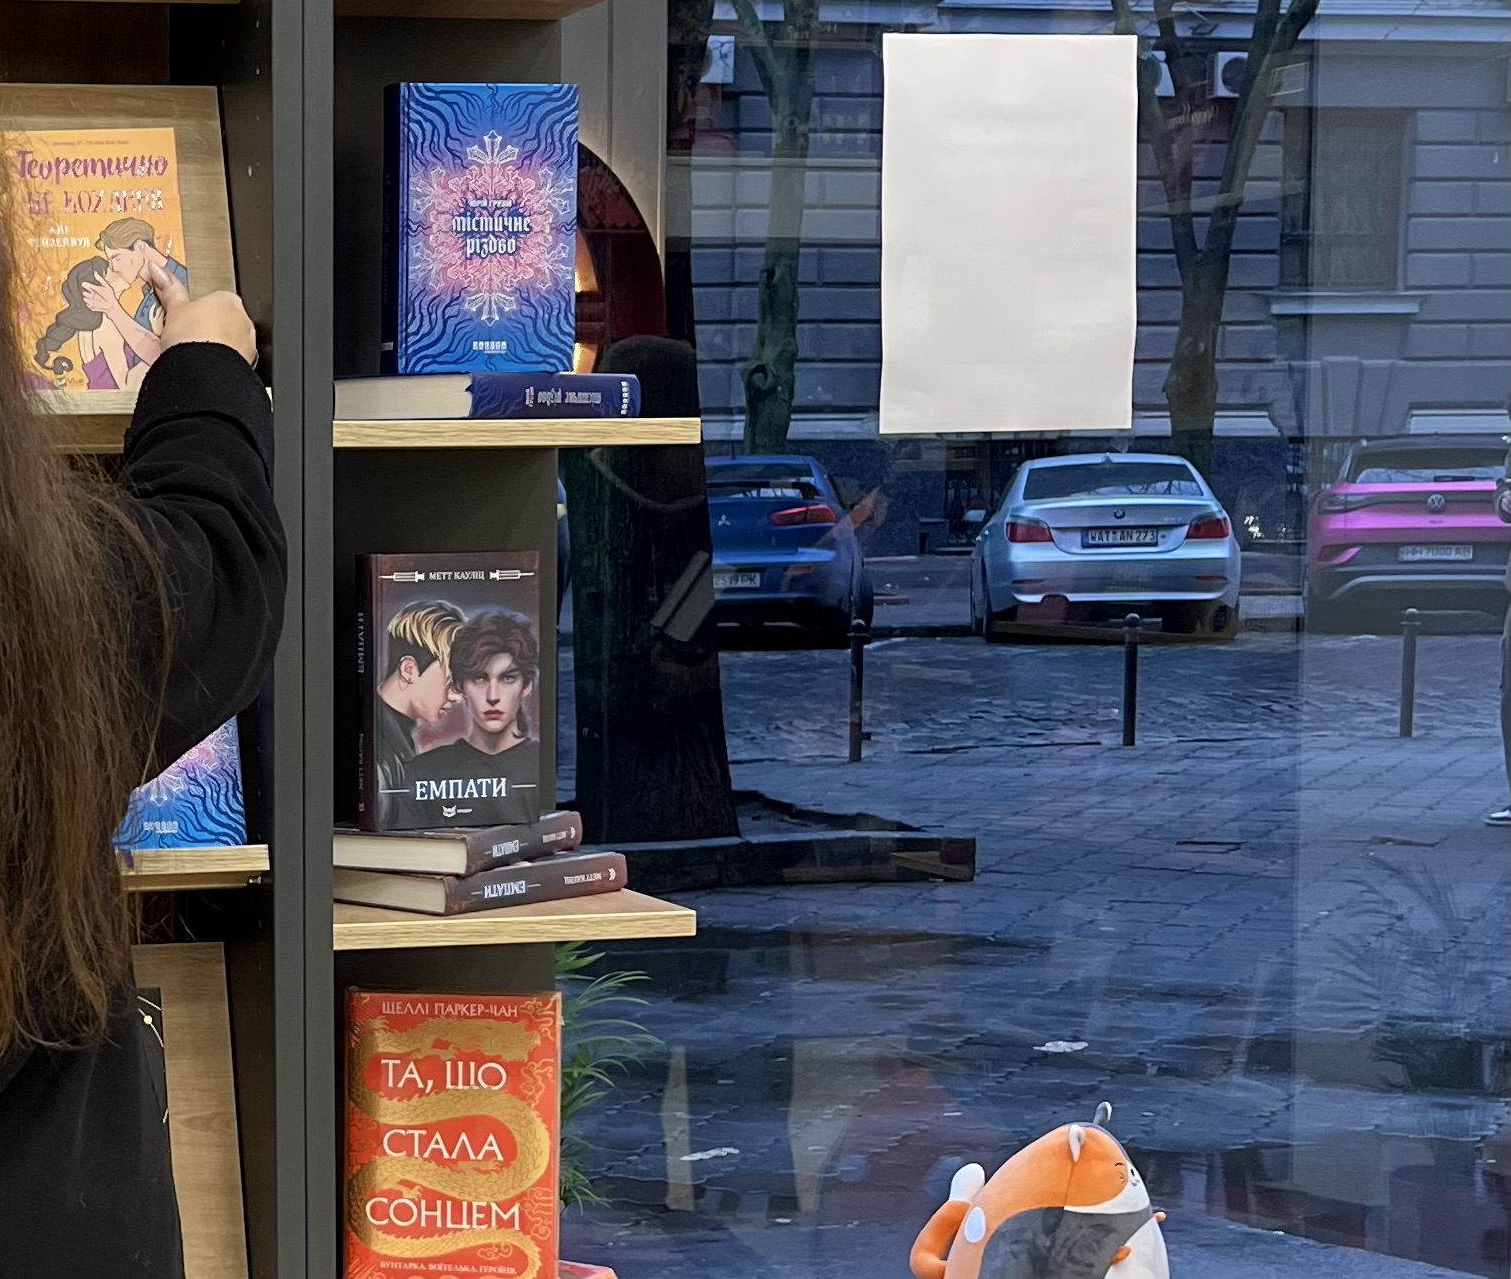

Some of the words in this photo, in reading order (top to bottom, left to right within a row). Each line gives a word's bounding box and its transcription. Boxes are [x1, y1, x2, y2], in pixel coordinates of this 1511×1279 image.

[452, 211, 531, 233] містичне
[466, 234, 517, 258] різдво
[1135, 529, 1155, 542] 273
[415, 777, 507, 801] ЕМПАТИ
[382, 1002, 428, 1015] ШЕЛЛІ
[434, 1003, 518, 1017] ПАРКЕР-ЧАН
[381, 1060, 434, 1093] ТА,
[446, 1061, 507, 1090] ЩО
[383, 1129, 504, 1161] СТАЛА
[366, 1197, 521, 1230] СОНЦЕМ
